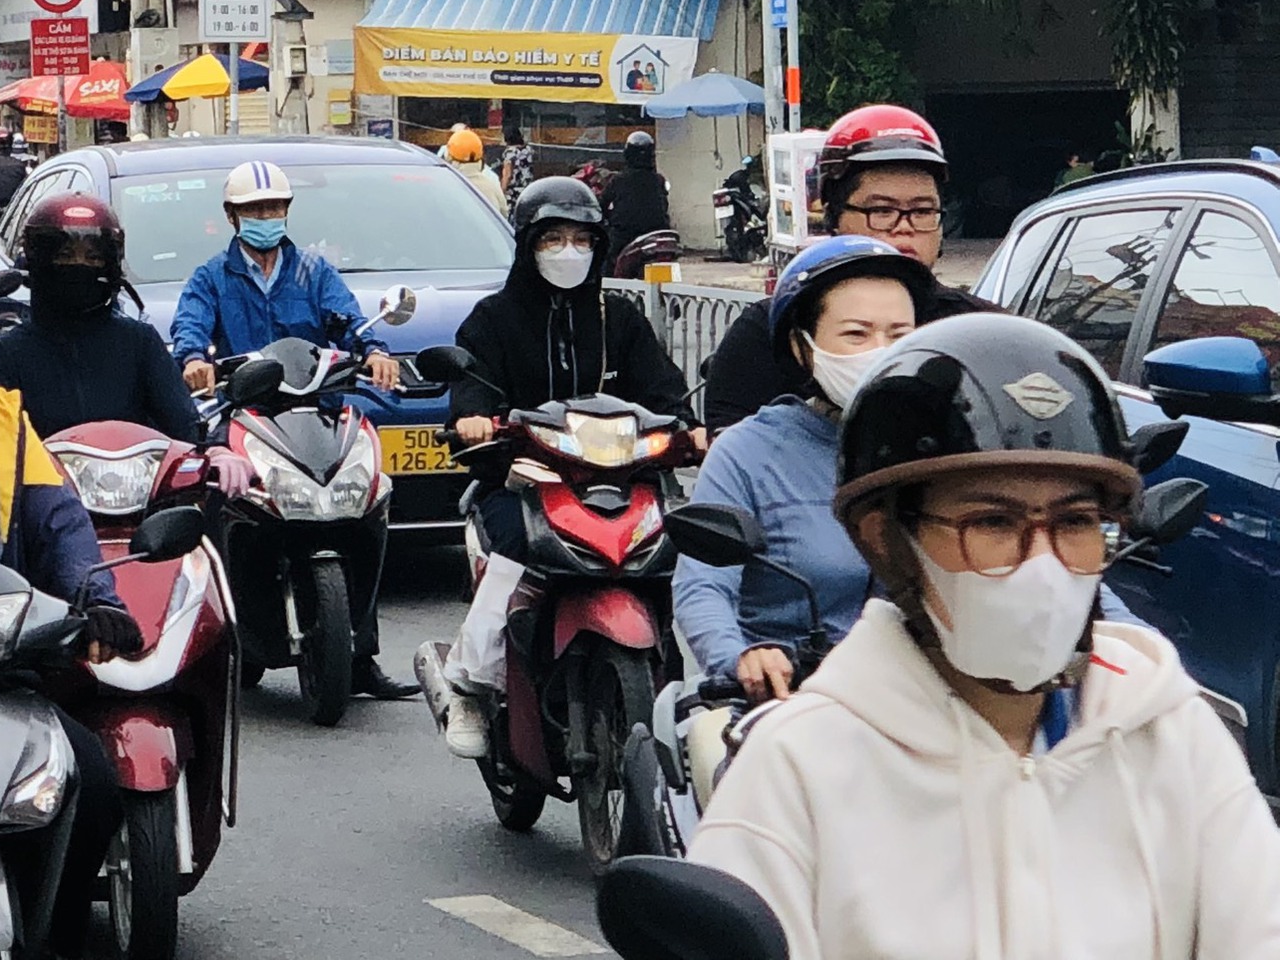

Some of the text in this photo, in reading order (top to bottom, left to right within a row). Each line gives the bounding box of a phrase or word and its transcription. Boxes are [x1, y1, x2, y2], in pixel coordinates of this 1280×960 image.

[49, 20, 71, 34] CẤM
[383, 45, 602, 66] ĐIỂM BÁN BẢO HIỂM Y TẾ
[141, 192, 181, 202] TAXI
